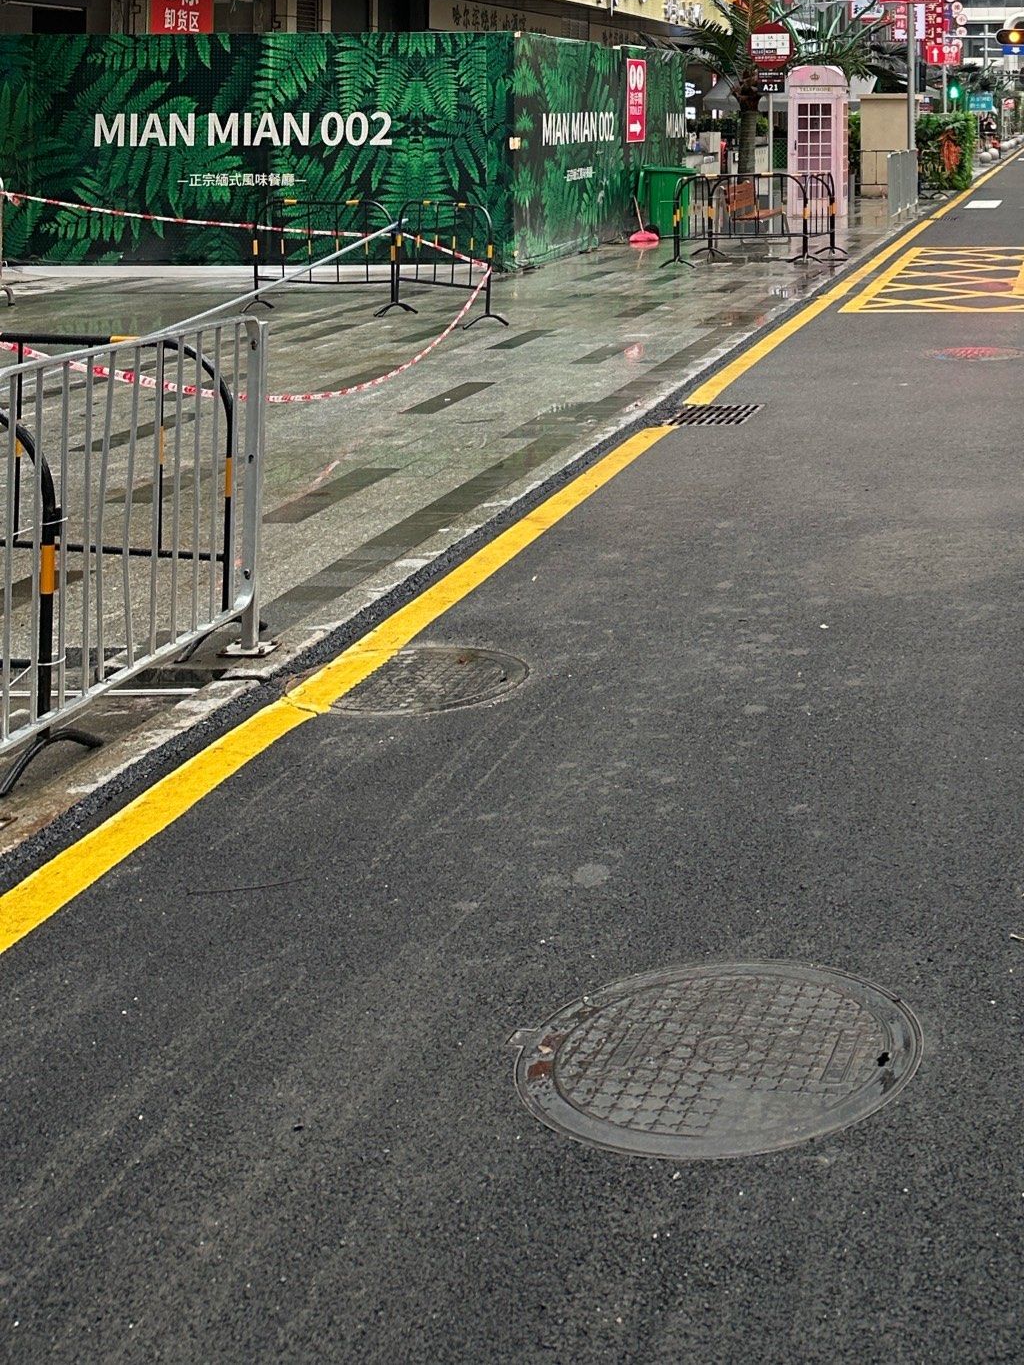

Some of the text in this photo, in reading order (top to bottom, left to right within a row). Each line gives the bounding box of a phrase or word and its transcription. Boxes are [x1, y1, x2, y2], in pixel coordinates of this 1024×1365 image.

[163, 6, 200, 33] 卸货区
[762, 83, 779, 92] A21
[93, 110, 393, 147] MIAN MIAN 002
[541, 111, 615, 147] MIAN MIAN 002
